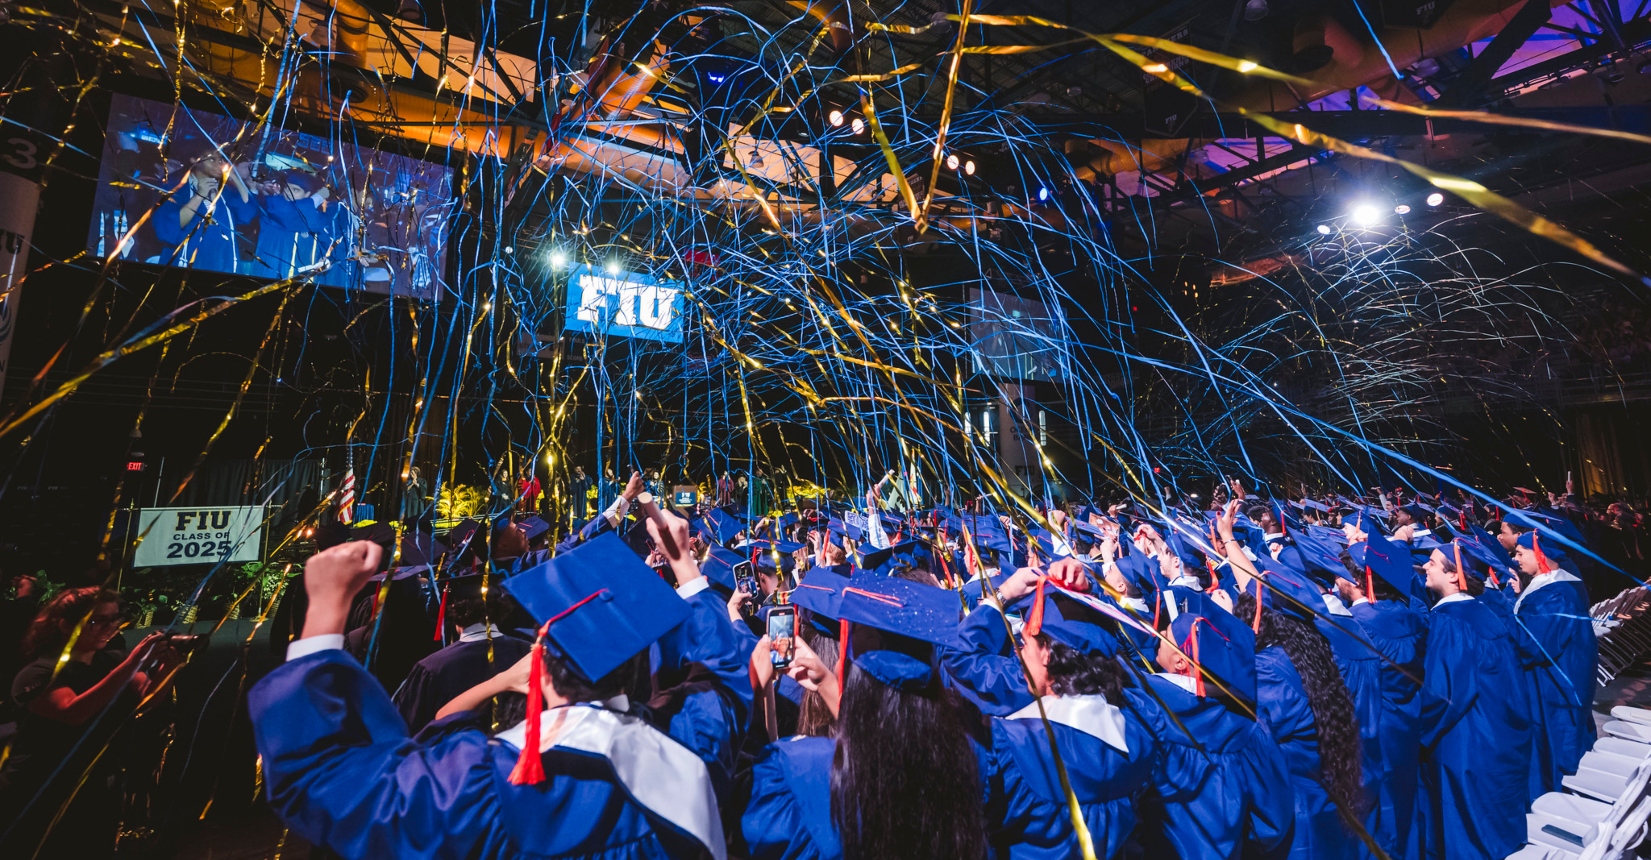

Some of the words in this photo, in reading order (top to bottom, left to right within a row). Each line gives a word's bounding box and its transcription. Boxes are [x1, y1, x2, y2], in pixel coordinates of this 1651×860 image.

[1416, 1, 1435, 15] FIU
[1165, 114, 1177, 124] FIU
[5, 138, 37, 169] 3
[577, 274, 679, 331] FIU
[128, 462, 142, 471] EXIT
[175, 510, 231, 531] FIU
[173, 532, 211, 541] CLASS
[215, 531, 230, 539] OF
[167, 541, 232, 559] 2025
